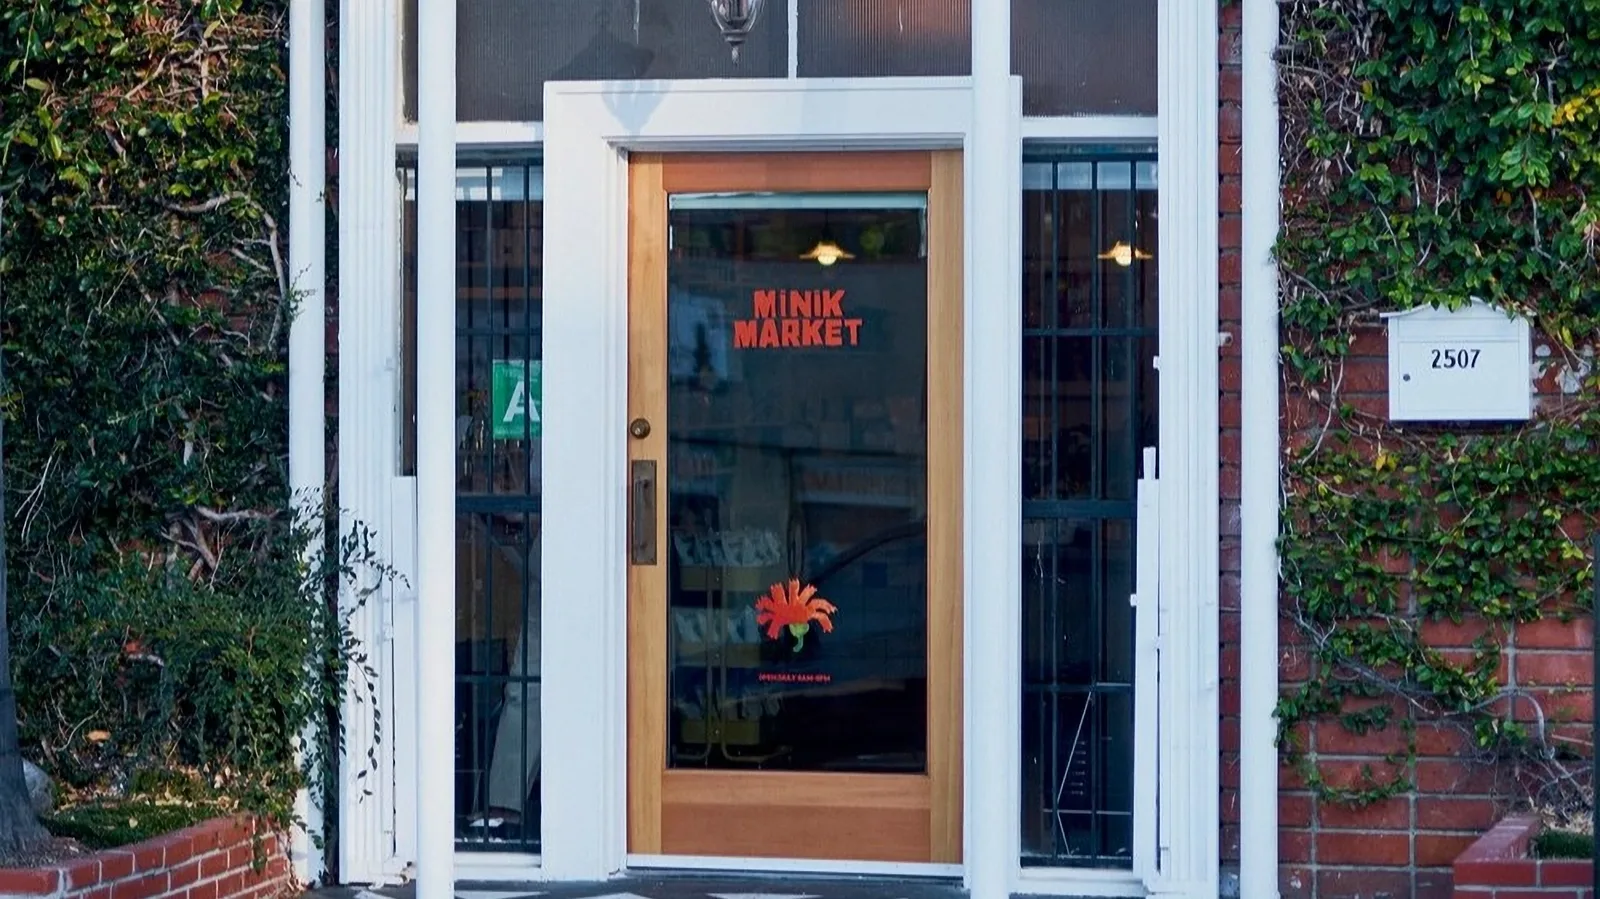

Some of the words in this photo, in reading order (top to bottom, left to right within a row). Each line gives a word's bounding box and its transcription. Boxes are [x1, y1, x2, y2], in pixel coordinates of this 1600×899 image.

[734, 318, 863, 348] MARKET
[1431, 348, 1481, 369] 2507
[503, 380, 541, 422] A
